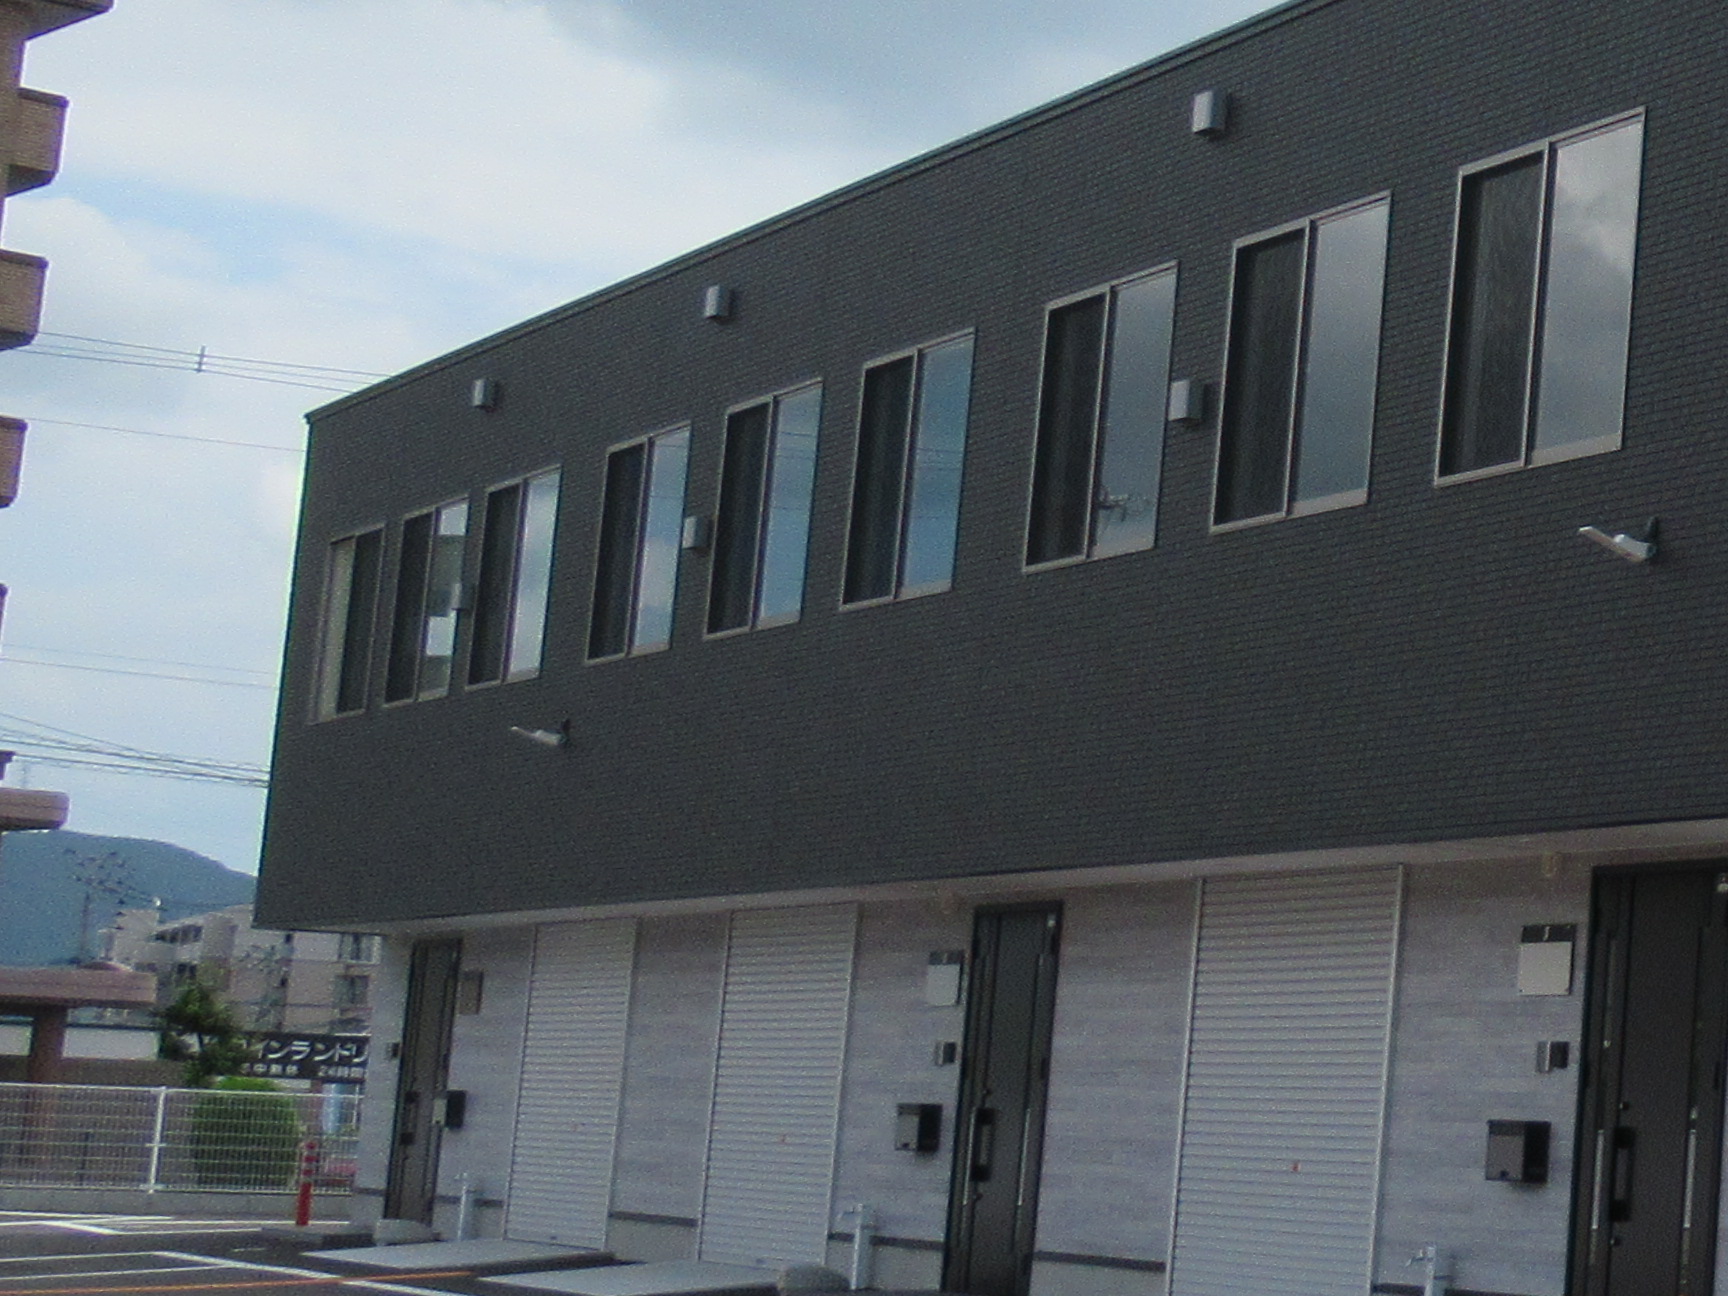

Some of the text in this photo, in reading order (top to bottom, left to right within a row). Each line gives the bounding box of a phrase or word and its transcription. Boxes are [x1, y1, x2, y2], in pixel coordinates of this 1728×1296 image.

[242, 1038, 368, 1063] インランドリ
